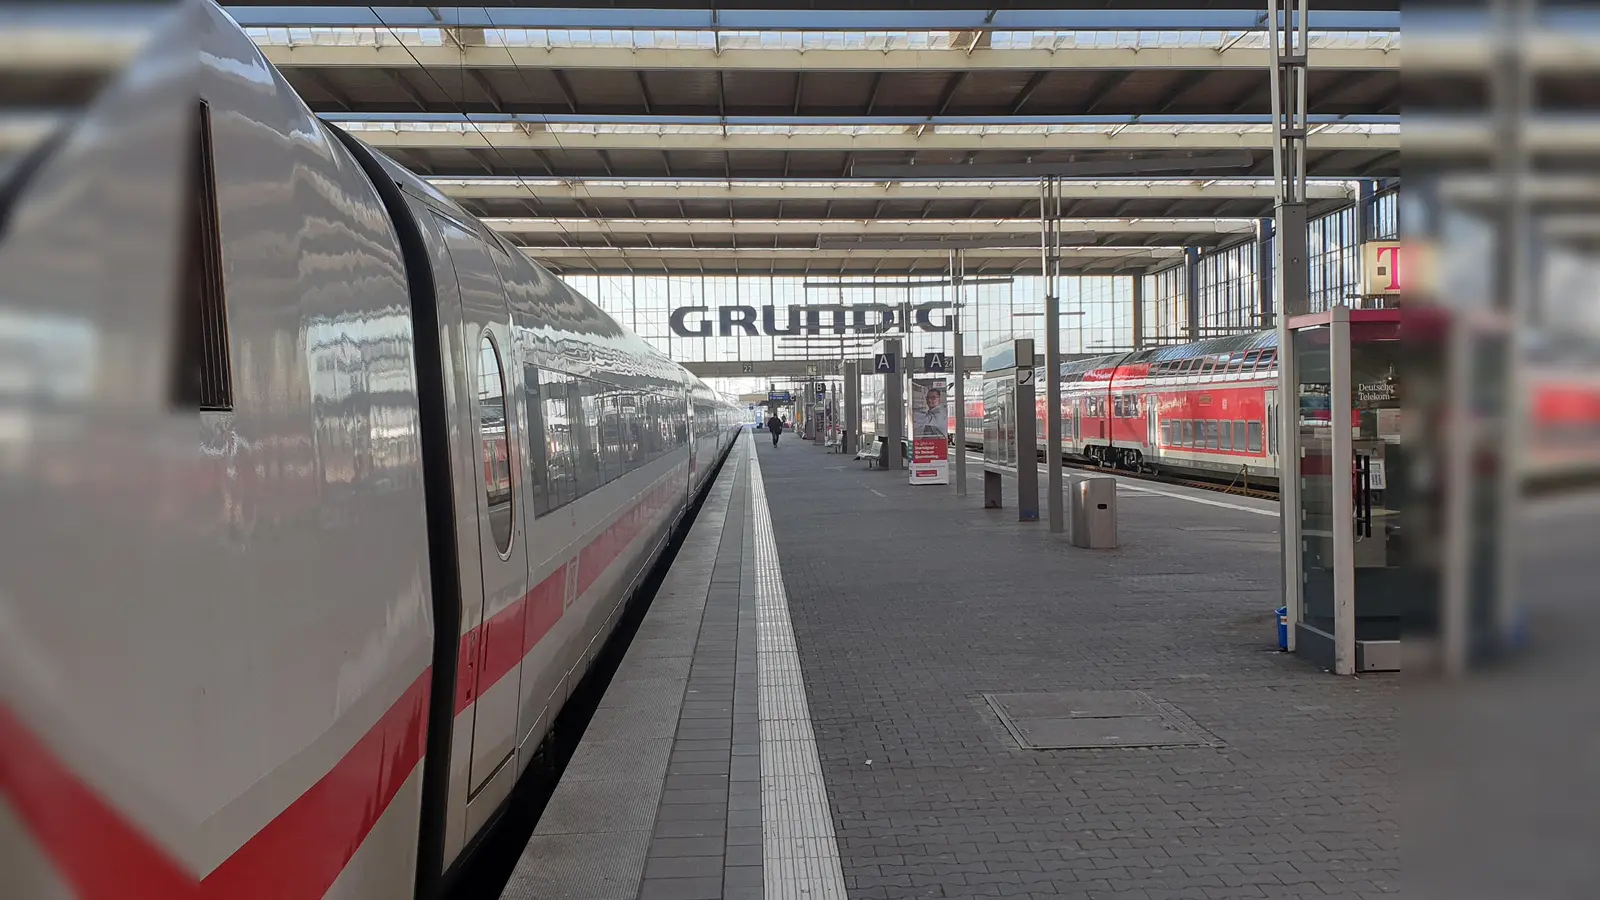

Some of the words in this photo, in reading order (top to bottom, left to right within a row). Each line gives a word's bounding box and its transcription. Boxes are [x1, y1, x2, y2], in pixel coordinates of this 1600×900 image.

[669, 301, 954, 337] GRUNDIG
[878, 354, 890, 369] A
[930, 353, 942, 368] A
[1358, 382, 1394, 393] Deutsche
[1358, 392, 1390, 401] Telekom
